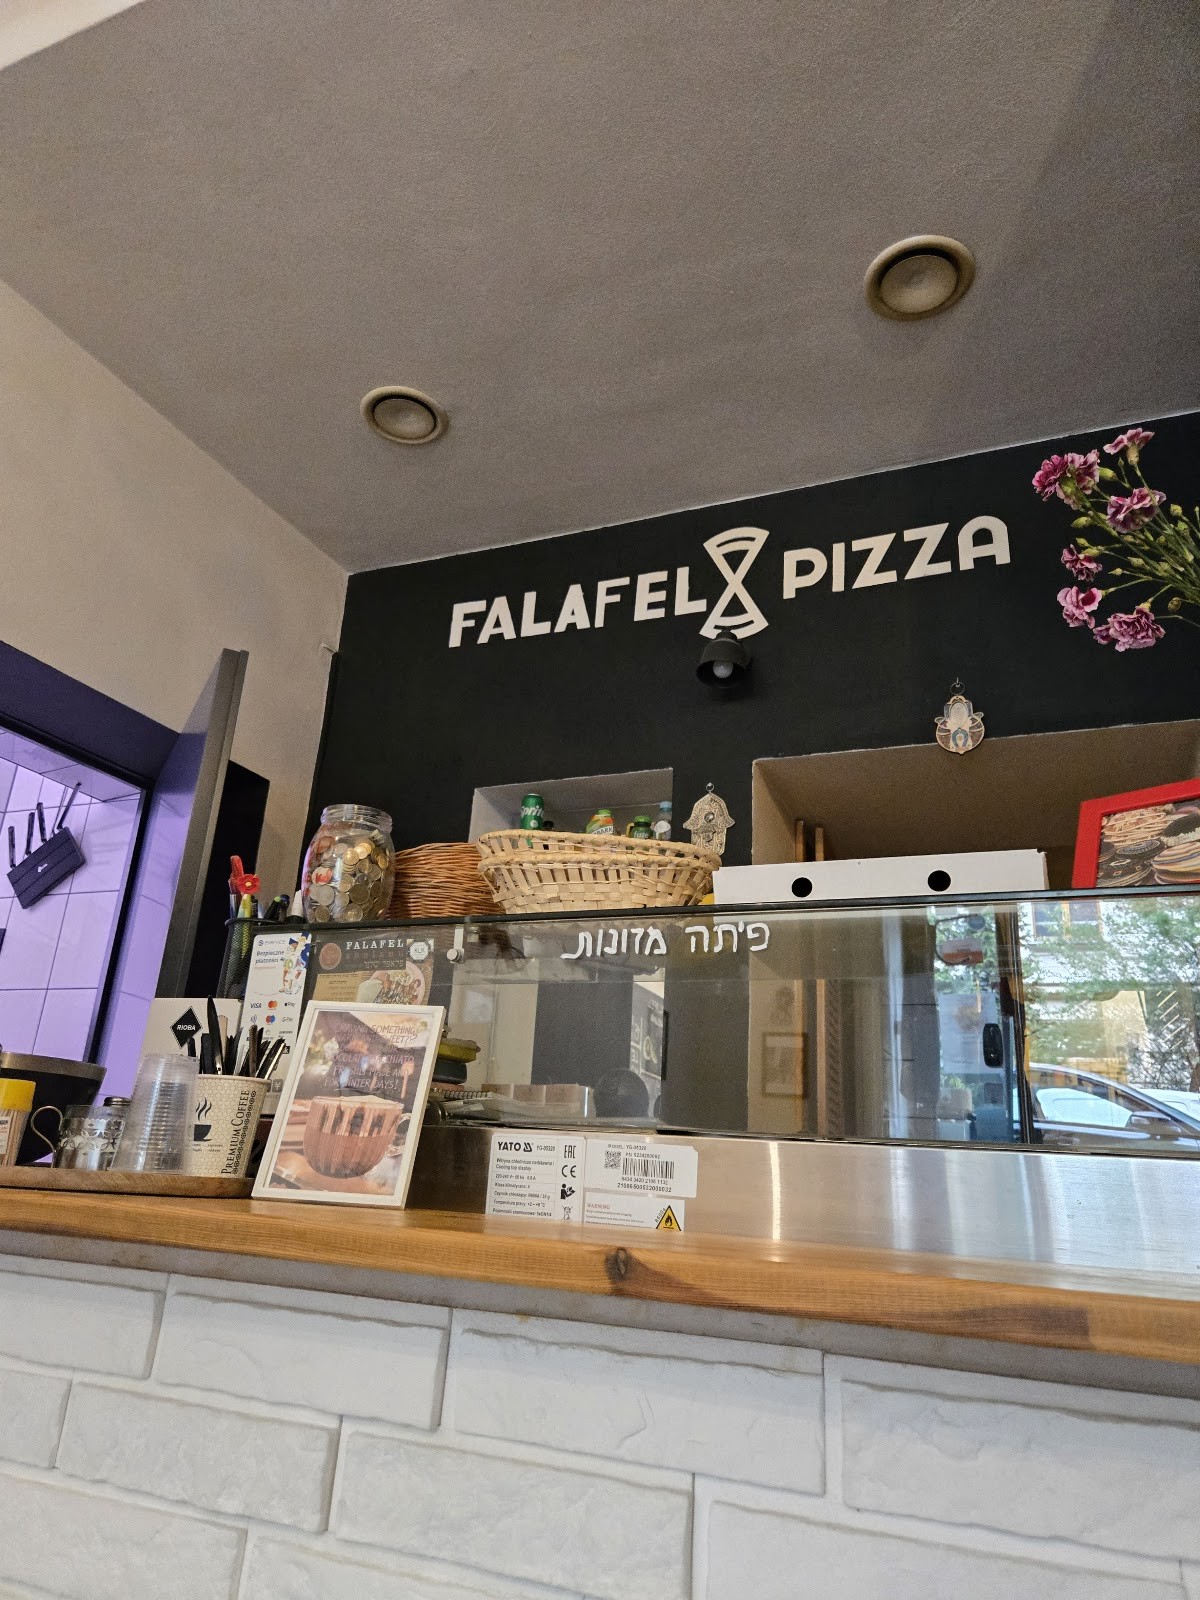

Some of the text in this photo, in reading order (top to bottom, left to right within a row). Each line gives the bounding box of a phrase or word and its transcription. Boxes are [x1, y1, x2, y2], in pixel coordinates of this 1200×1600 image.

[448, 515, 1012, 649] FALAFEL PIZZA
[346, 938, 404, 950] FALAFEL
[560, 920, 770, 960] פיתה מזונות
[332, 1065, 366, 1077] FRSHLY
[221, 1090, 250, 1174] PREMIUM COFFEE
[498, 1141, 522, 1152] YATO
